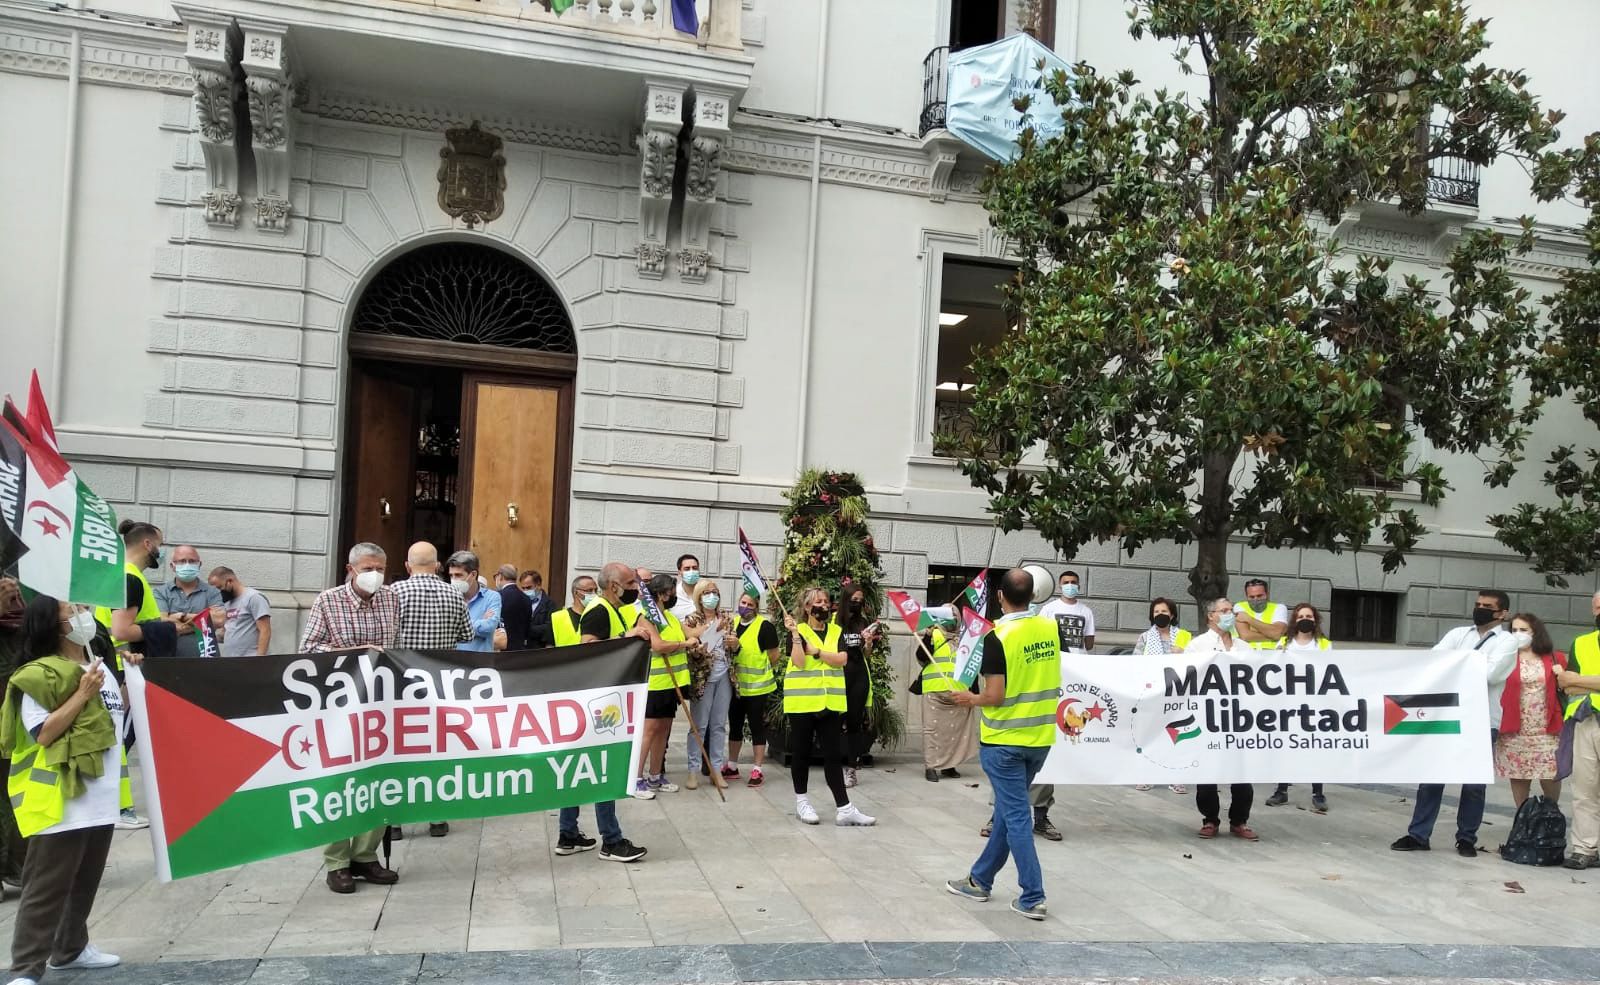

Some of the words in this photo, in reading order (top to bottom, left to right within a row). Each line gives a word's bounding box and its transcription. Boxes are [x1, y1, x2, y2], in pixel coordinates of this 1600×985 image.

[1023, 640, 1055, 654] MARCHA
[281, 655, 504, 714] Sáhara
[1164, 663, 1350, 697] MARCHA
[1066, 683, 1087, 693] CON
[1089, 685, 1101, 697] EL
[1101, 692, 1118, 728] SAHARA
[1164, 701, 1184, 714] por
[1187, 699, 1198, 711] la
[1205, 699, 1367, 733] libertad
[315, 699, 587, 769] LIBERTAD
[1208, 741, 1221, 750] del
[1225, 734, 1283, 750] Pueblo
[1289, 734, 1369, 750] Saharaui
[289, 765, 533, 829] Referendum
[547, 750, 608, 790] YA!
